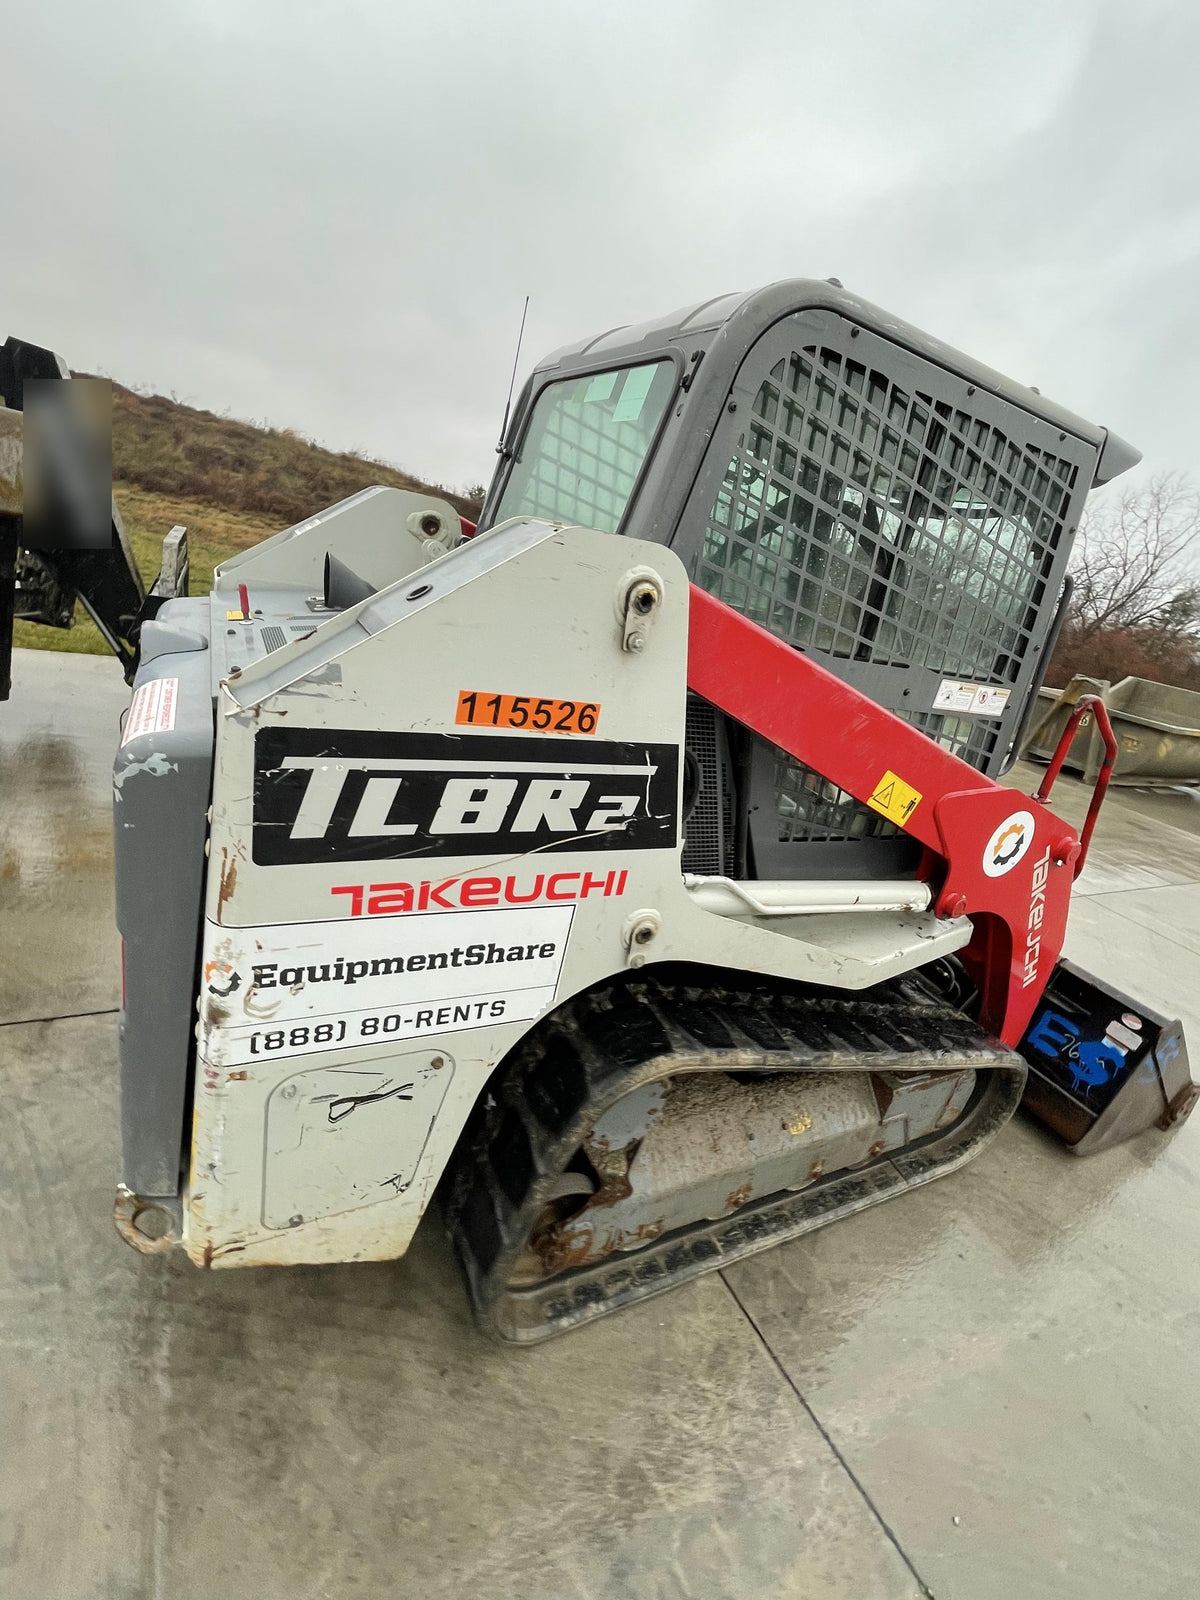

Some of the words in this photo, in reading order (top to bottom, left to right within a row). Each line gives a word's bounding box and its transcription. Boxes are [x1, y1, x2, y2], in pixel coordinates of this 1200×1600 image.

[460, 691, 597, 733] 115526
[281, 756, 658, 840] TL8R2
[251, 940, 557, 990] EquipmentShare
[249, 1022, 346, 1055] (888)
[360, 999, 506, 1037] 80-RENTS
